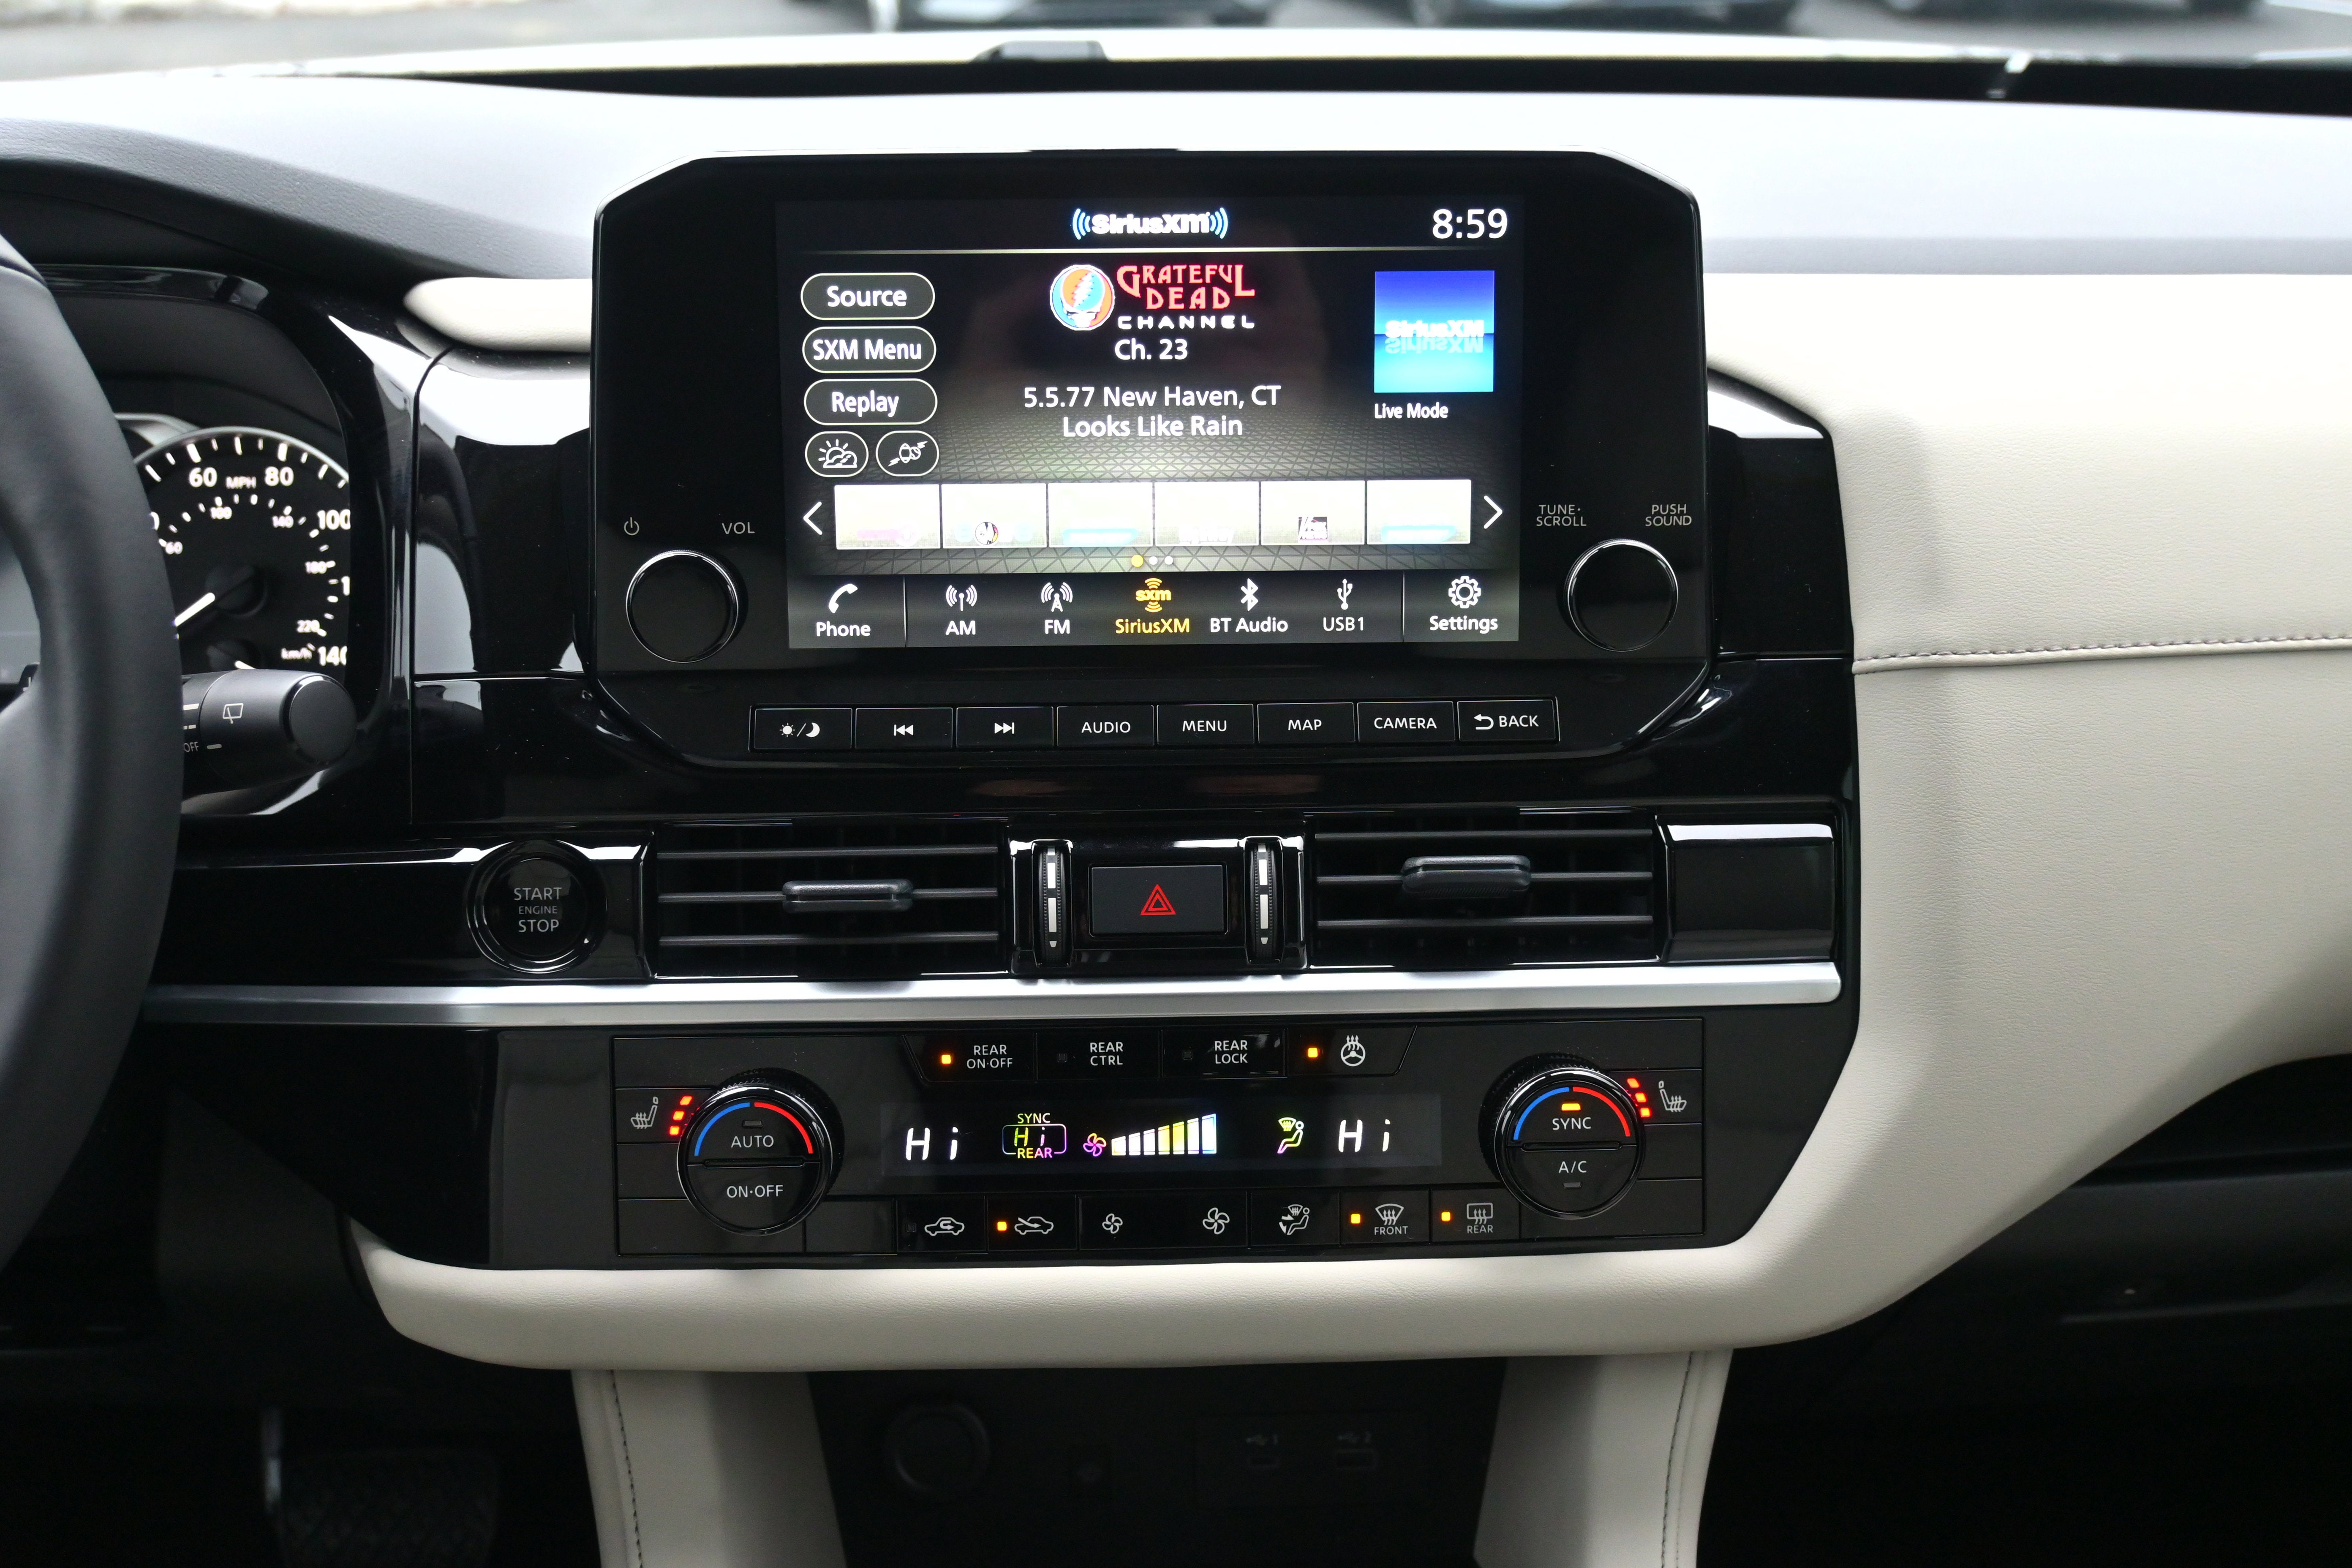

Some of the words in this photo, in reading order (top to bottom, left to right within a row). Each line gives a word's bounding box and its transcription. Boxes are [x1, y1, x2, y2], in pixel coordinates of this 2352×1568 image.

[1432, 208, 1508, 239] 8:59
[1117, 264, 1255, 297] GRATEFUL
[827, 285, 907, 308] Source
[1146, 287, 1230, 309] DEAD
[1118, 315, 1255, 329] CHANNEL
[1385, 320, 1484, 338] SiriusXM
[812, 339, 858, 361] SXM
[864, 338, 922, 360] Menu
[1114, 338, 1152, 360] Ch.
[1159, 338, 1188, 360] 23
[832, 389, 899, 417] Replay
[1024, 387, 1095, 408] 5.5.77
[1103, 387, 1157, 407] New
[1164, 386, 1244, 409] Haven,
[1251, 385, 1282, 406] CT
[1375, 403, 1403, 419] Live
[1407, 401, 1448, 419] Mode
[1063, 416, 1130, 438] Looks
[1138, 416, 1184, 437] Like
[1191, 415, 1243, 436] Rain
[188, 467, 218, 487] 60
[226, 476, 256, 489] MPH
[264, 466, 294, 486] 80
[210, 507, 232, 520] 100
[1652, 504, 1686, 514] PUSH
[272, 516, 294, 528] 140
[317, 509, 351, 530] 100
[1536, 516, 1587, 526] SCROLL
[1645, 515, 1692, 526] SOUND
[721, 522, 755, 534] VOL
[165, 542, 183, 555] 60
[1135, 589, 1171, 601] sxm
[297, 620, 320, 633] 220
[816, 622, 871, 637] Phone
[945, 620, 976, 635] AM
[1045, 619, 1070, 634] FM
[1115, 618, 1190, 634] SiriusXM
[1210, 618, 1232, 633] BT
[1235, 616, 1288, 632] Audio
[1323, 617, 1364, 632] USB1
[1429, 615, 1498, 634] Settings
[280, 647, 312, 660] km/h
[1081, 721, 1131, 733] AUDIO
[1182, 720, 1227, 732] MENU
[1288, 719, 1322, 731] MAP
[1374, 717, 1437, 729] CAMERA
[1499, 715, 1539, 727] BACK
[514, 887, 562, 901] START
[519, 906, 558, 914] ENGINE
[518, 919, 559, 932] STOP
[974, 1044, 1007, 1056] REAR
[1090, 1041, 1123, 1053] REAR
[1214, 1040, 1247, 1051] REAR
[1090, 1055, 1123, 1066] CTRL
[1215, 1053, 1248, 1064] LOCK
[1017, 1113, 1051, 1124] SYNC
[1552, 1117, 1591, 1130] SYNC
[731, 1135, 774, 1148] AUTO
[1017, 1147, 1053, 1159] REAR
[1558, 1160, 1587, 1173] A/C
[1374, 1226, 1408, 1235] FRONT
[1467, 1225, 1493, 1233] REAR
